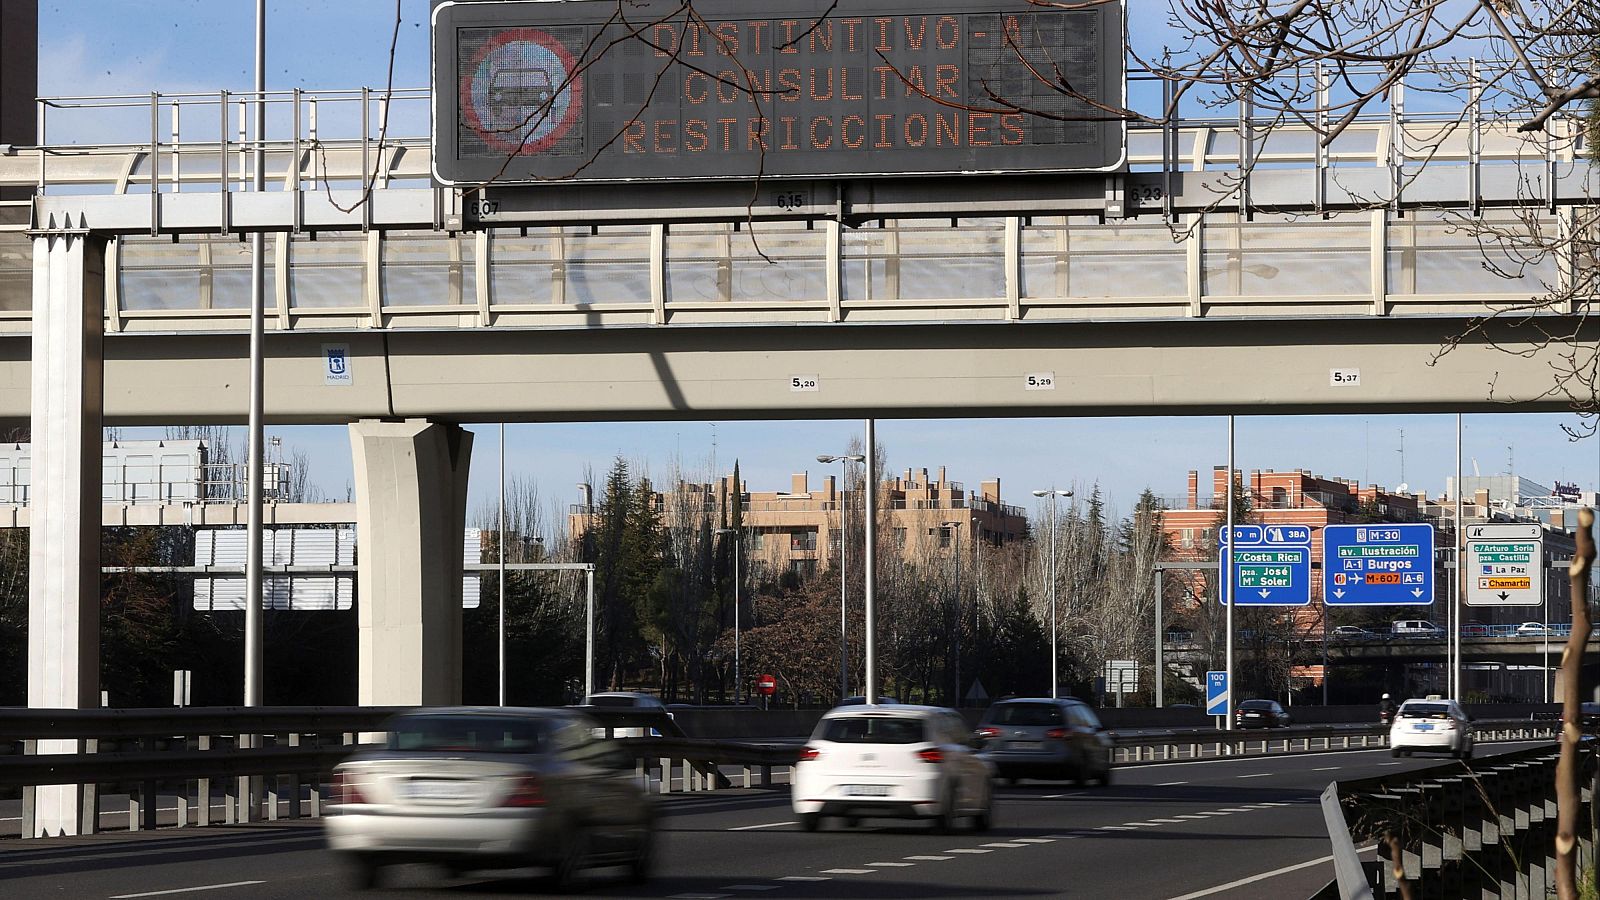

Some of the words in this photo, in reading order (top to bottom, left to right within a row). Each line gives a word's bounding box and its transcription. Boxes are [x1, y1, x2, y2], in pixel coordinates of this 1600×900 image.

[685, 64, 959, 104] CONSULTAR
[623, 112, 1024, 153] RESTRICCIONES
[792, 377, 815, 388] 5,20
[1028, 376, 1051, 387] 5,29
[1334, 372, 1357, 383] 5,37
[1370, 531, 1399, 540] M-30
[1340, 548, 1356, 556] av.
[1361, 546, 1416, 556] Ilustración
[1277, 552, 1300, 562] Rica
[1345, 560, 1362, 569] A-1
[1367, 559, 1412, 571] Burgos
[1495, 566, 1506, 574] La
[1510, 566, 1525, 574] Paz
[1241, 569, 1258, 577] pza.
[1263, 566, 1288, 576] José
[1260, 577, 1288, 586] Soler
[1366, 574, 1400, 583] M-607
[1404, 574, 1423, 583] A-6
